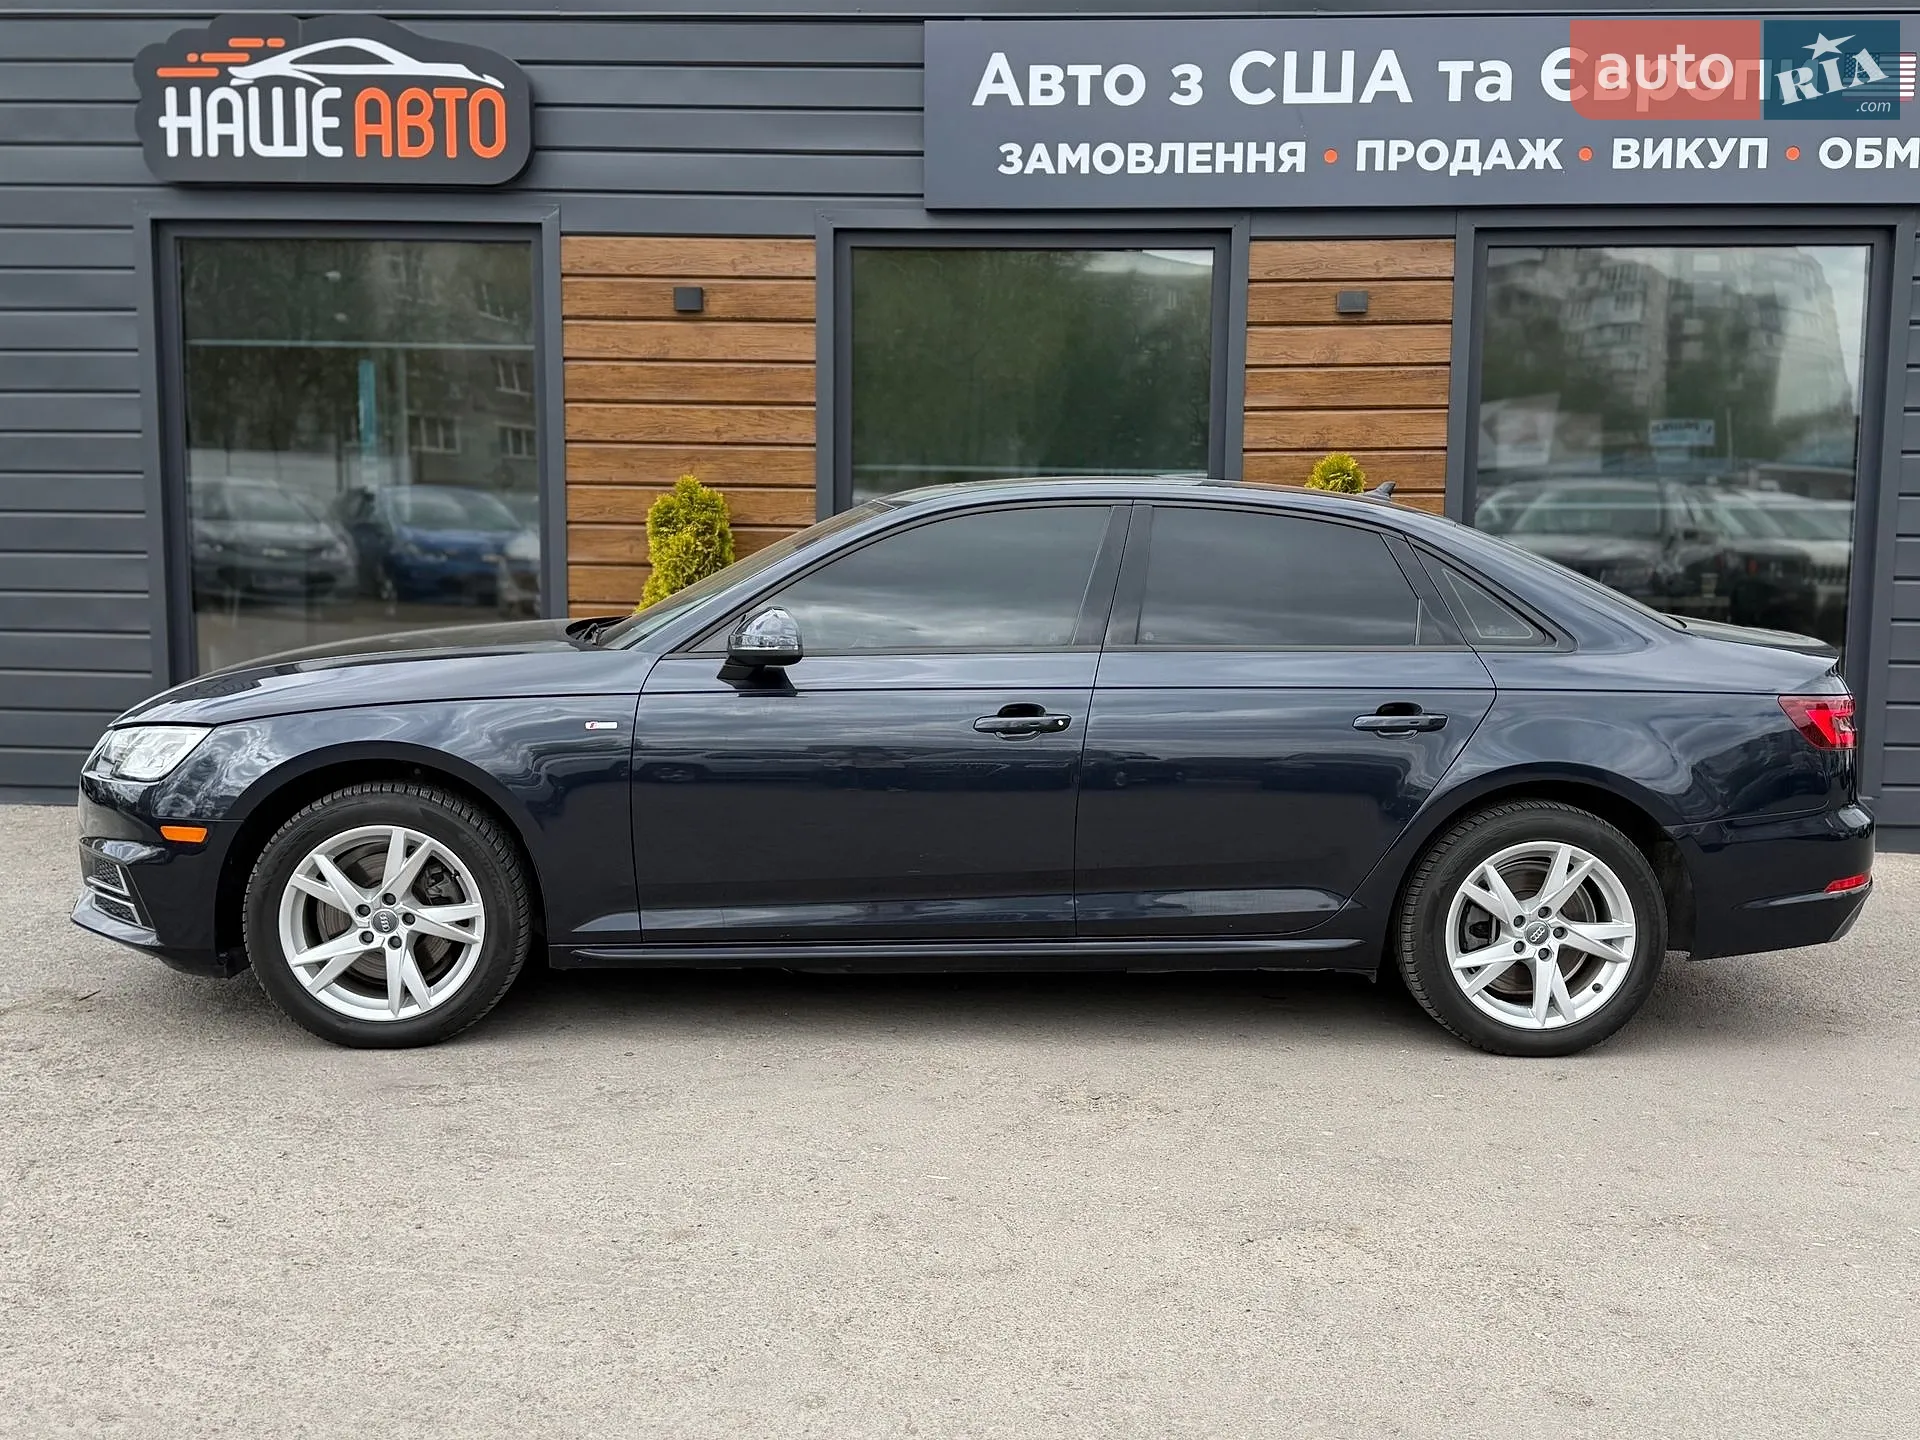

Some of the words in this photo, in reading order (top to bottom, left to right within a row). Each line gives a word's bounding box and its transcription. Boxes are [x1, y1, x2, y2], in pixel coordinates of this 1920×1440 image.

[971, 52, 1146, 107] Авто
[1169, 63, 1204, 106] з
[1229, 49, 1413, 106] США
[1438, 60, 1513, 103] та
[158, 86, 344, 158] НАШЕ
[354, 87, 507, 159] АВТО
[997, 141, 1306, 175] ЗАМОВЛЕННЯ
[1356, 138, 1564, 177] ПРОДАЖ
[1612, 137, 1769, 170] ВИКУП
[1818, 136, 1920, 170] ОБМ
